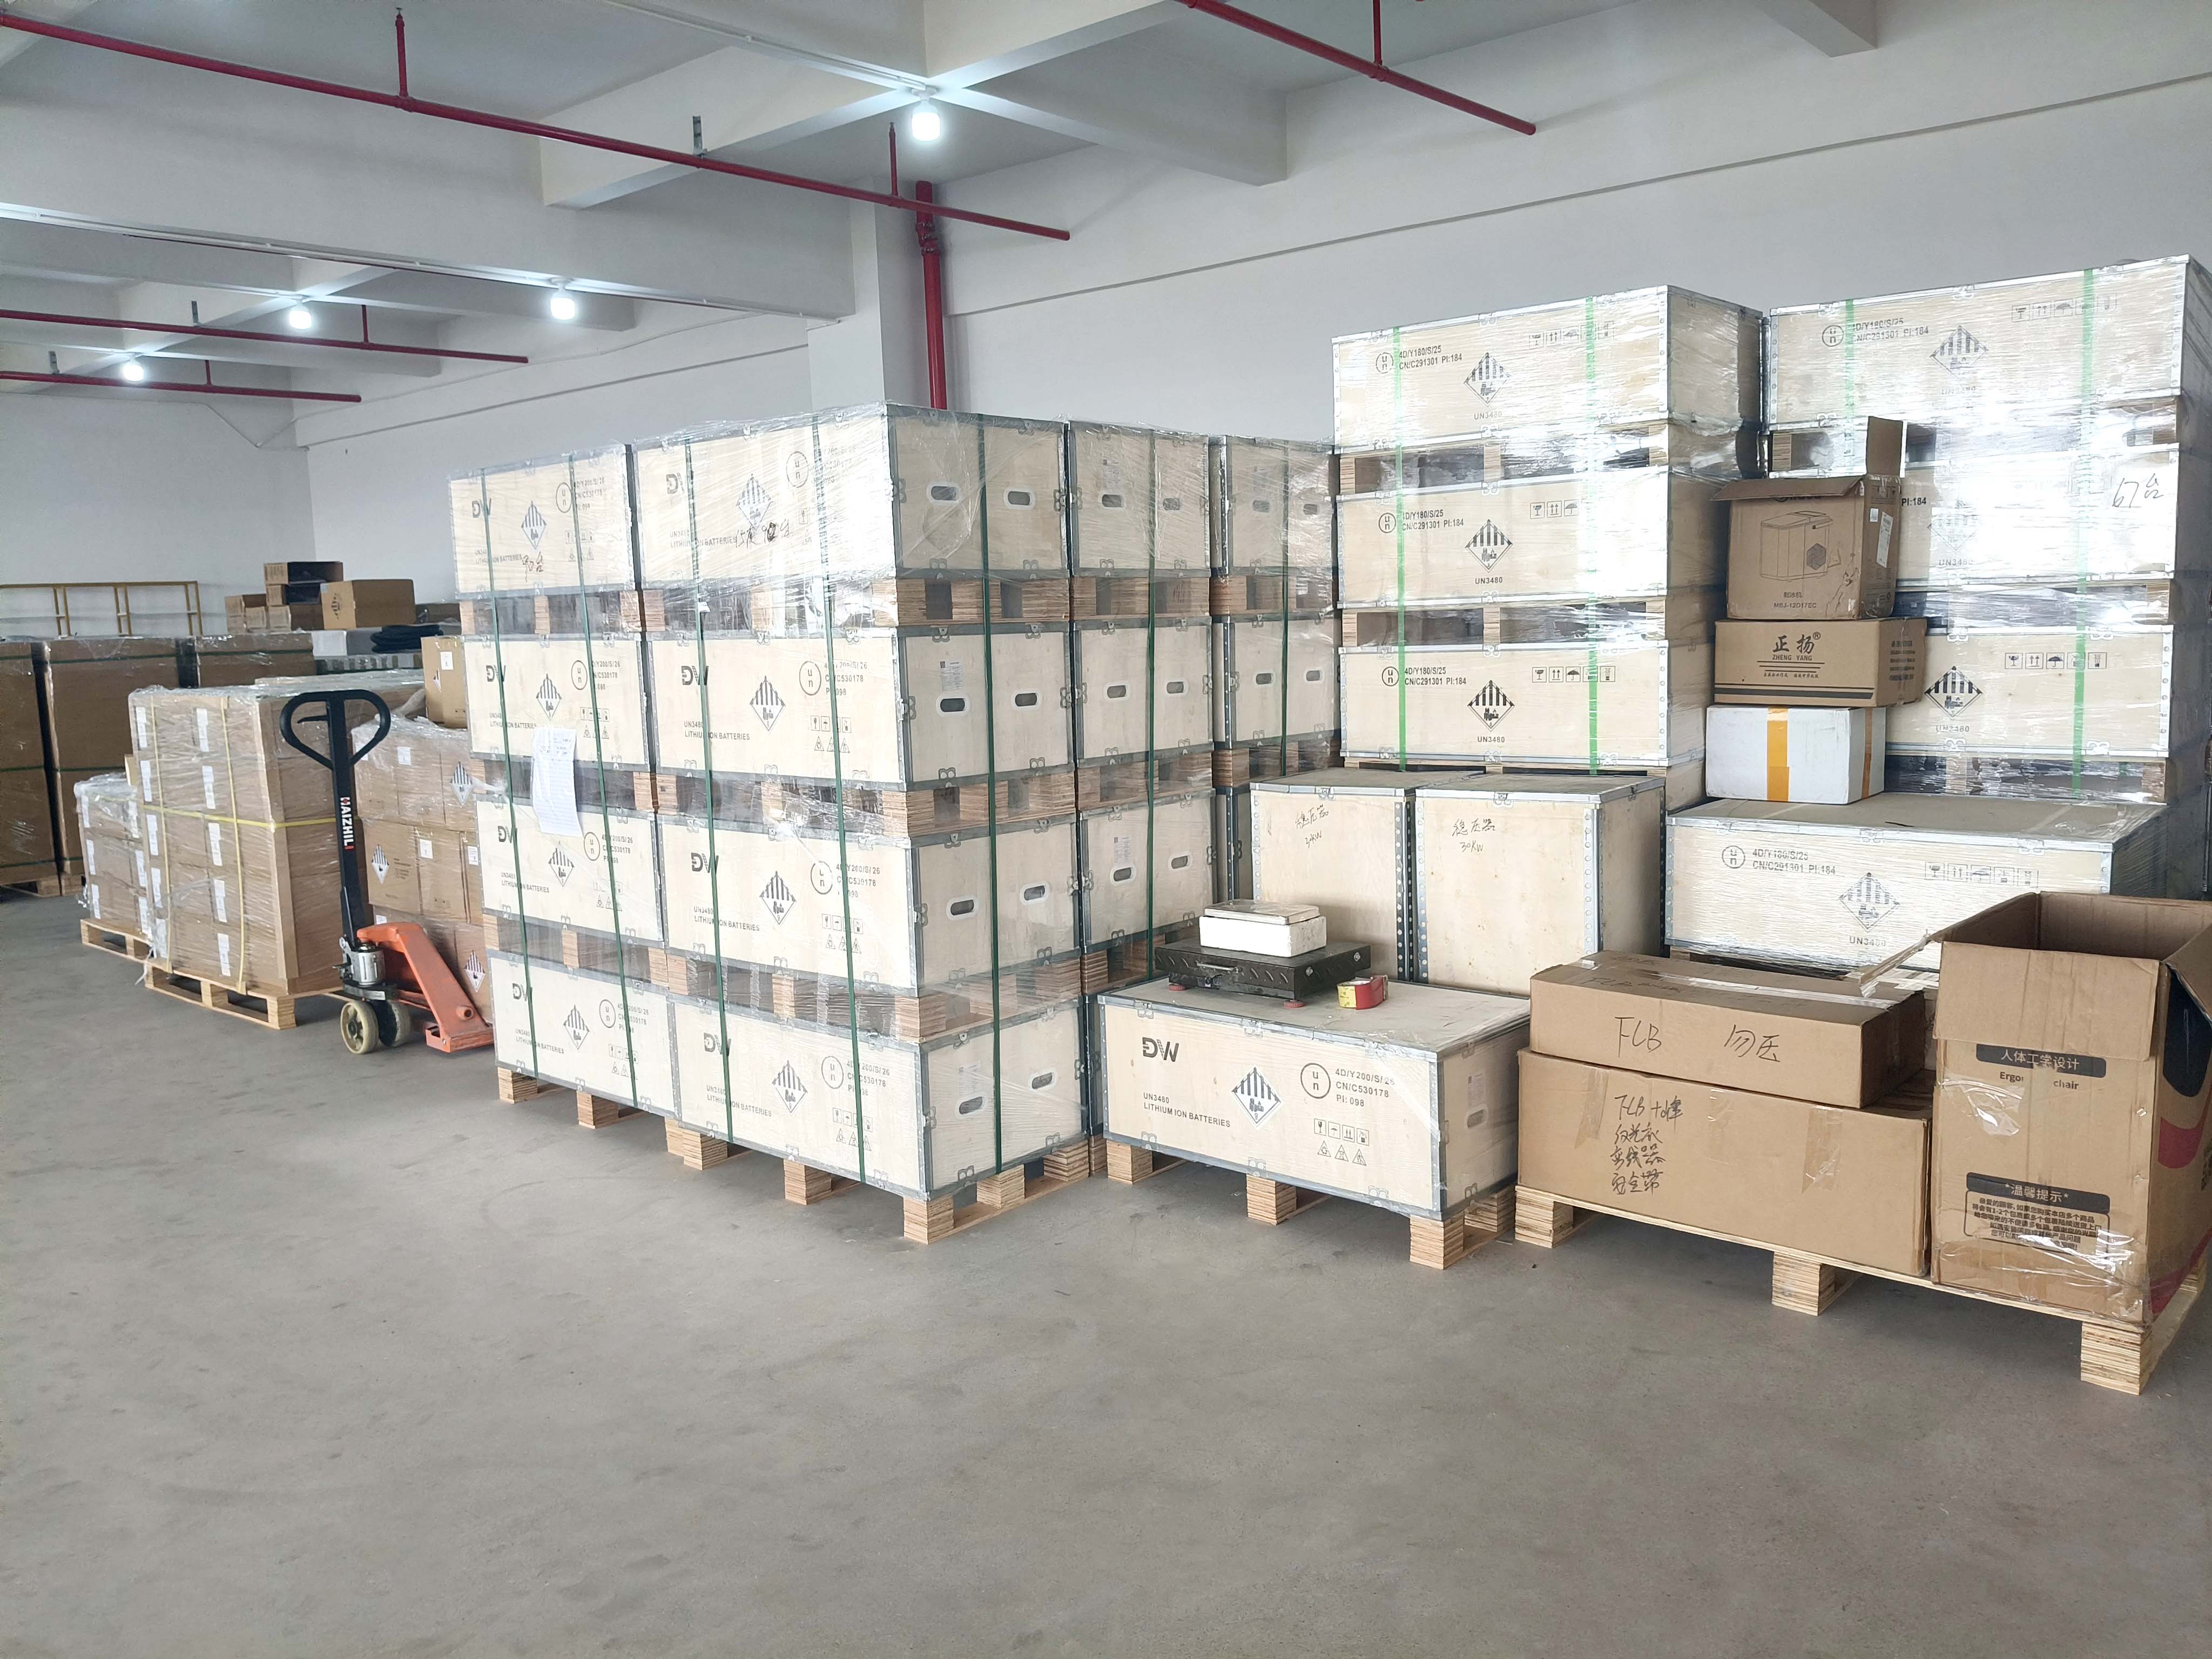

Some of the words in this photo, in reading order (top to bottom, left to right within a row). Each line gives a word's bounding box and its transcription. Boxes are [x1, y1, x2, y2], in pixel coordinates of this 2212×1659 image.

[1399, 345, 1441, 359] 4D/Y180/S/25
[1442, 353, 1462, 363] PI:184
[1901, 497, 1926, 507] PI:184
[1402, 520, 1440, 531] CN/C291301
[1444, 518, 1464, 528] PI:184
[1772, 634, 1815, 655] 正扬
[1404, 677, 1442, 685] CN/C291301
[719, 732, 750, 740] BATTERIES
[729, 921, 760, 932] BATTERIES
[1142, 1037, 1179, 1062] DW
[2000, 1049, 2080, 1071] 人体工学设计
[1336, 1081, 1390, 1098] CN/C530178
[2053, 1080, 2079, 1090] chair
[741, 1103, 772, 1117] BATTERIES
[1144, 1102, 1173, 1115] LITHIUM
[1175, 1109, 1188, 1118] ION
[1189, 1111, 1231, 1128] BATTERIES
